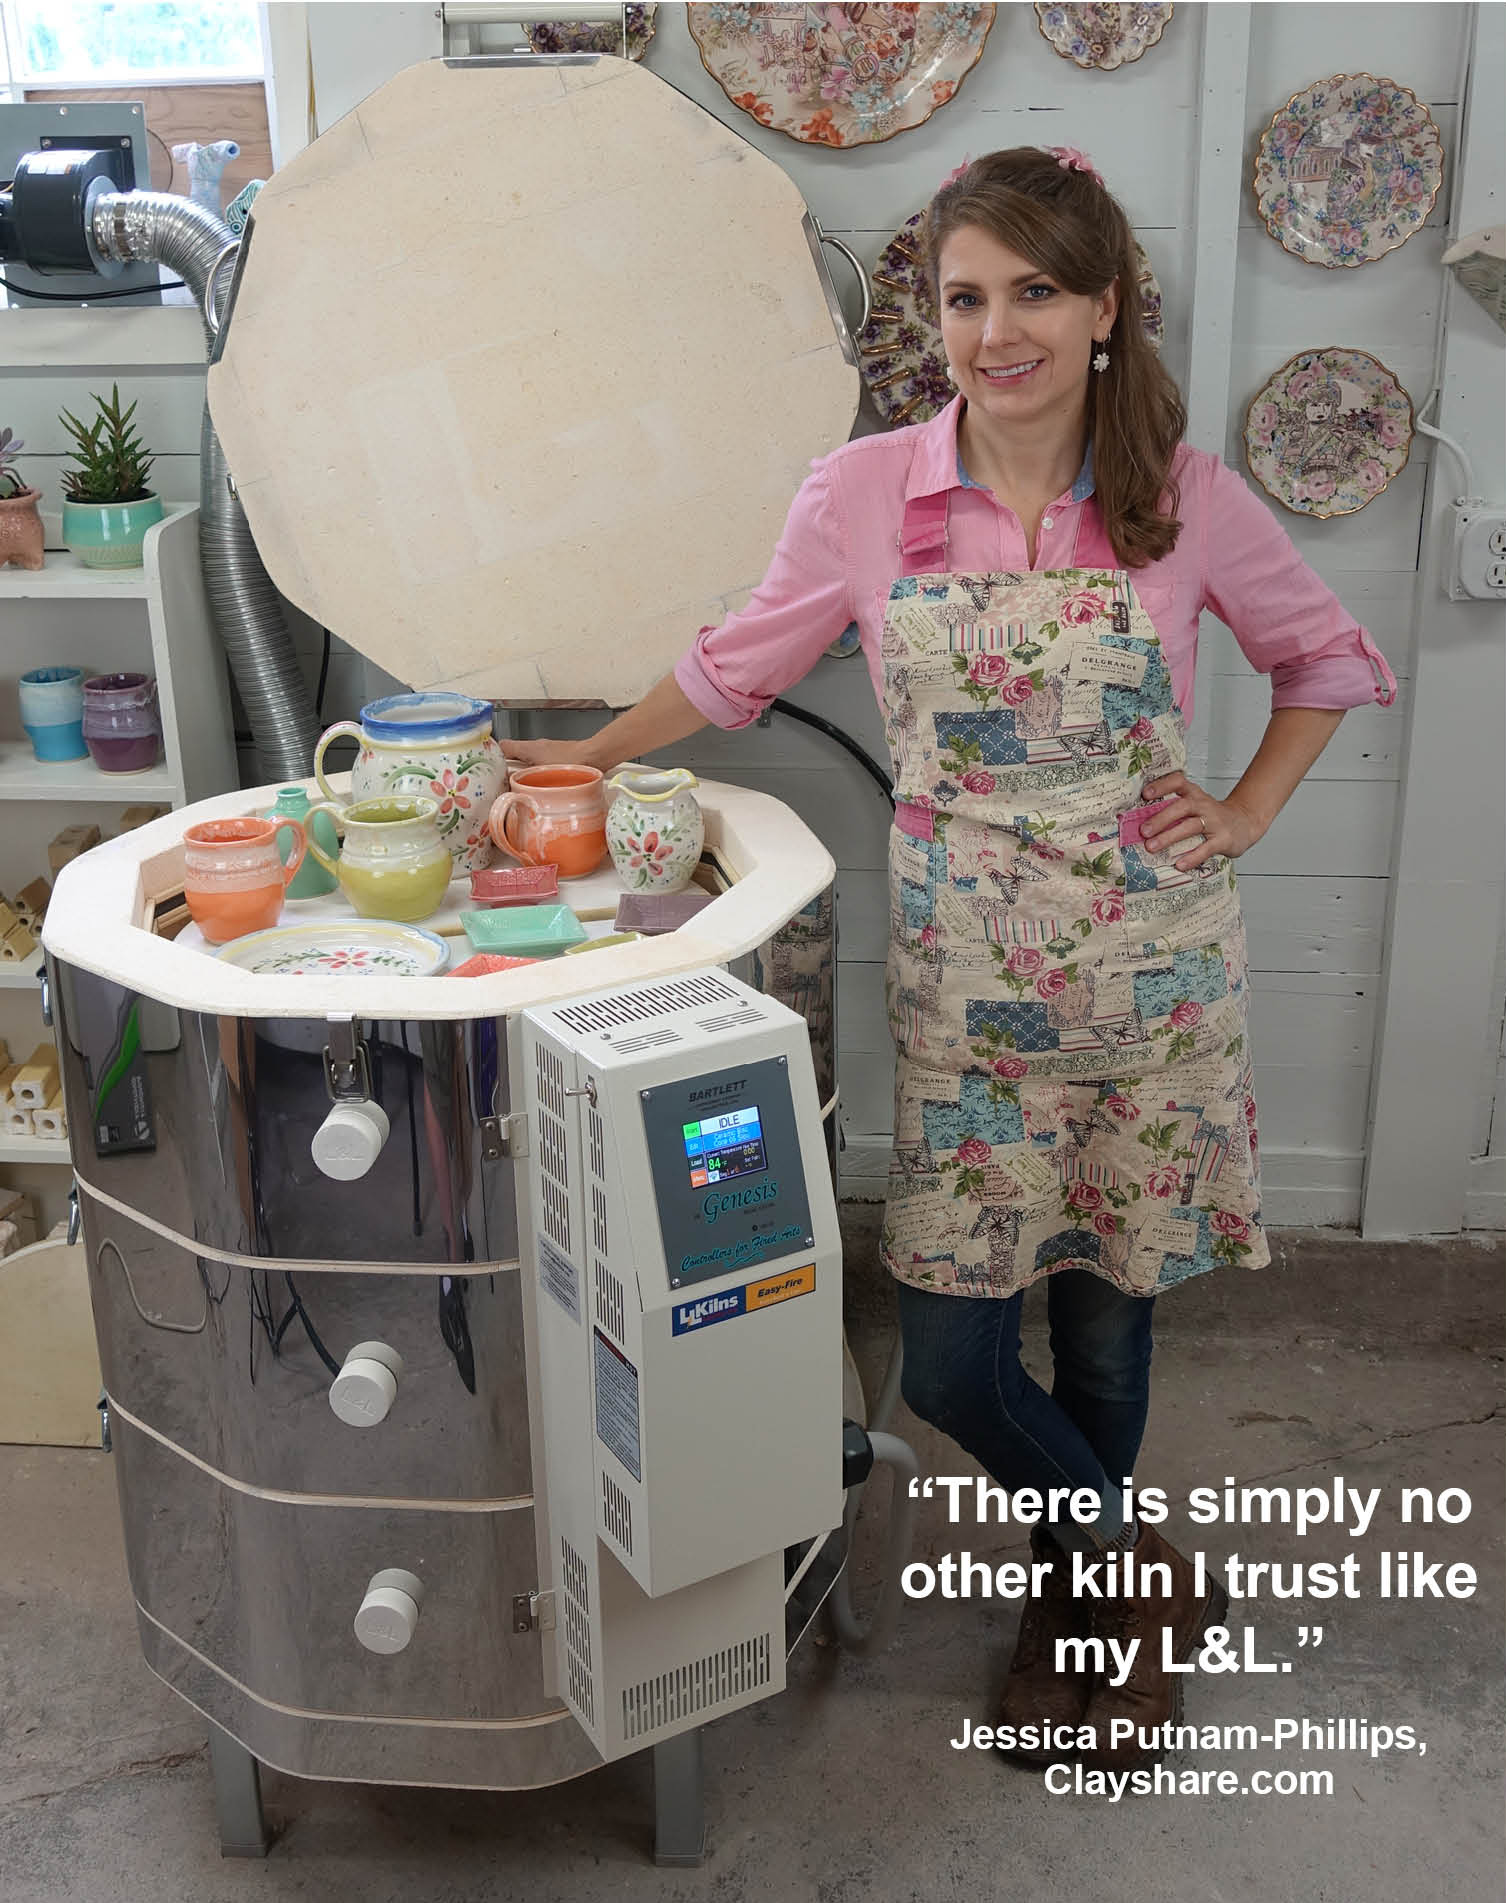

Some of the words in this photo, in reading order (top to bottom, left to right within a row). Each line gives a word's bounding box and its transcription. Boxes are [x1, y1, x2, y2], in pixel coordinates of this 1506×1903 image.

[1082, 656, 1137, 671] DELGRANGE
[689, 1080, 747, 1102] BARTLETT
[719, 1114, 740, 1128] IDLE
[691, 1158, 702, 1166] Load
[708, 1158, 721, 1170] 84
[703, 1177, 778, 1224] Genesis
[681, 1248, 732, 1272] Controllers
[734, 1240, 749, 1258] for
[751, 1232, 778, 1250] Fired
[757, 1278, 804, 1298] Easy-Fire
